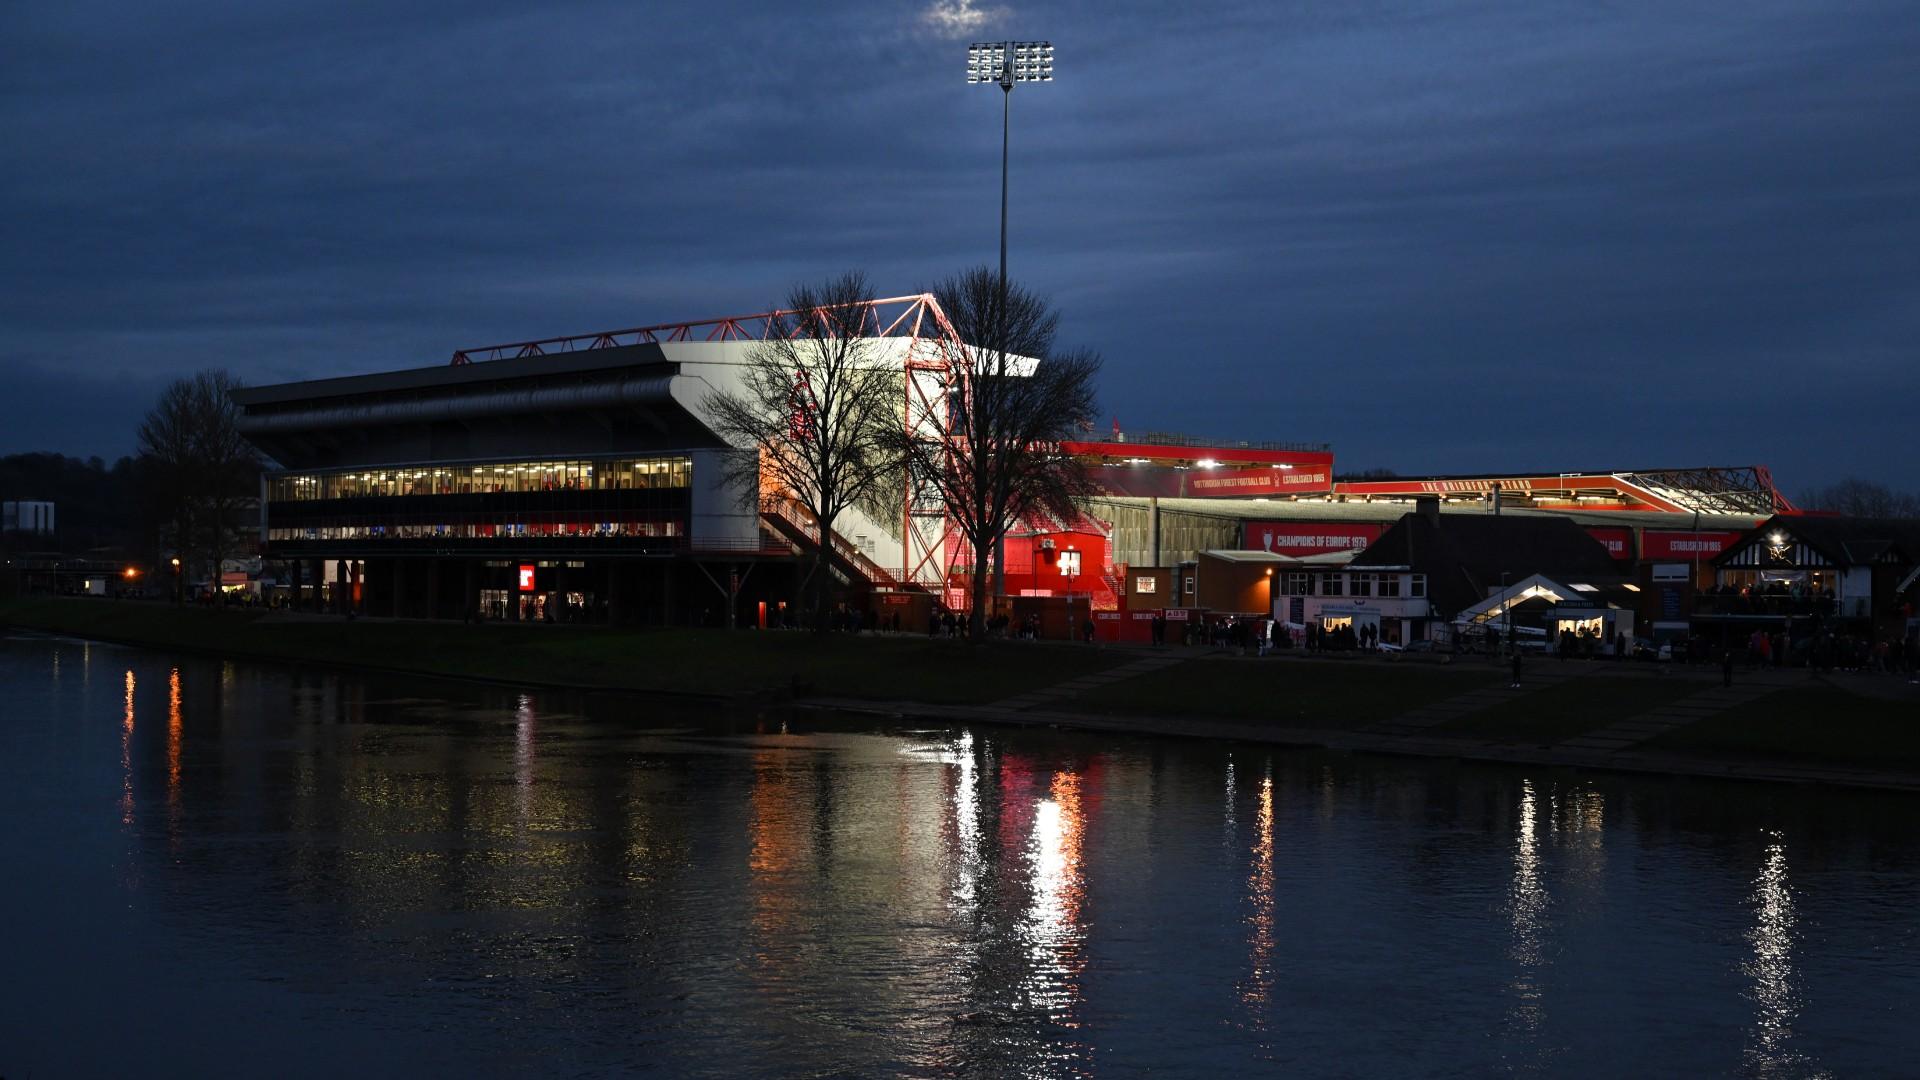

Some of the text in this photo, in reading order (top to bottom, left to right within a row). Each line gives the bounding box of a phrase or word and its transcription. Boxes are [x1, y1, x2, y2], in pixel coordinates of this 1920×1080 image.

[1258, 476, 1271, 486] CLUB
[1283, 475, 1312, 484] ESTABLISHED
[1421, 482, 1439, 491] THE
[1500, 479, 1531, 490] STAND
[1277, 535, 1367, 548] CHAMPIONS OF EUROPE 1979
[1702, 541, 1708, 552] IN
